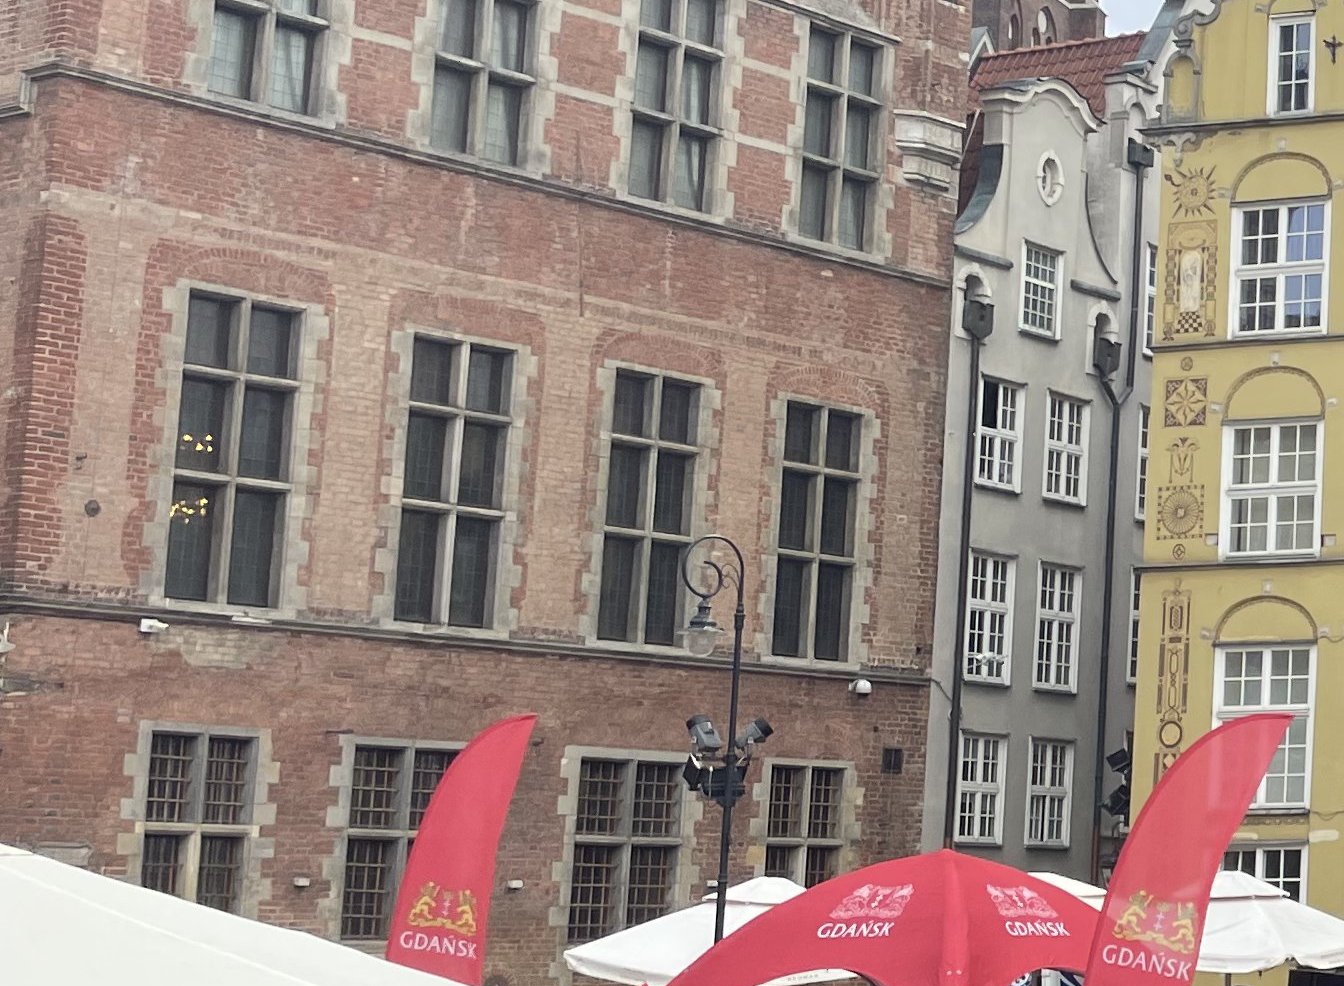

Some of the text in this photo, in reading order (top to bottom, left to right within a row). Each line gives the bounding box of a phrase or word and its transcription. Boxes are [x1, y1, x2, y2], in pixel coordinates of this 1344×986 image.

[817, 920, 895, 938] GDAŃSK
[1005, 919, 1071, 937] GDAŃSK
[400, 931, 477, 959] GDAŃSK
[1102, 944, 1192, 981] GDAŃSK
